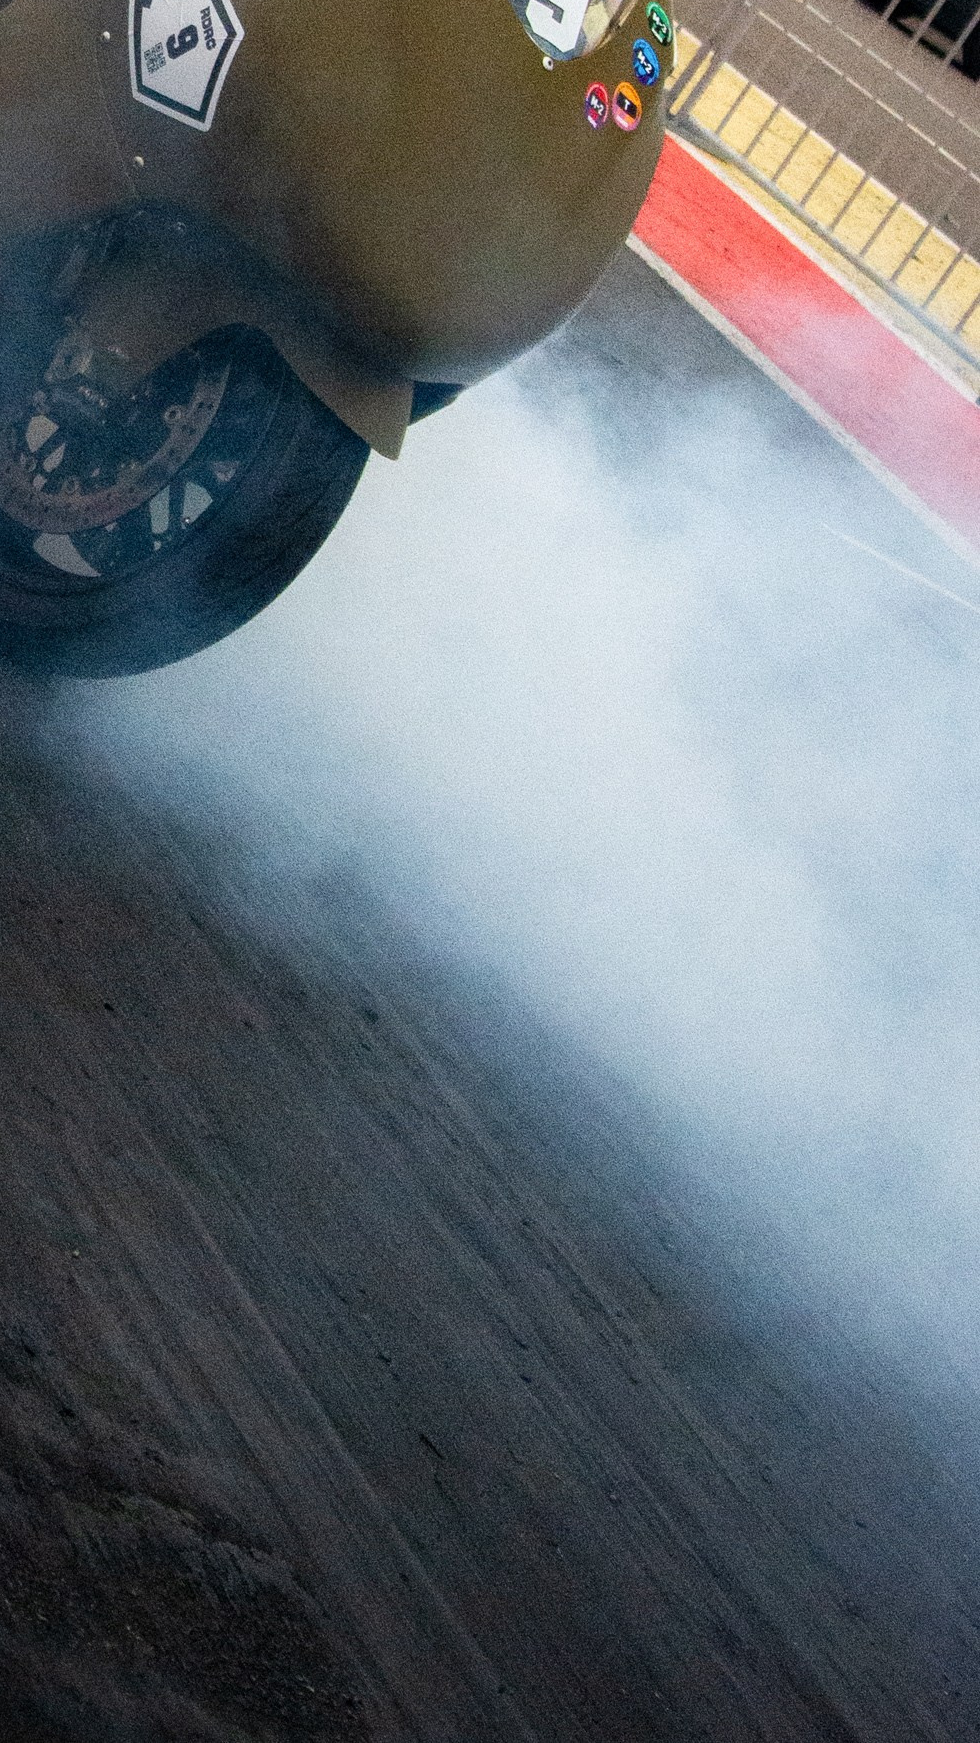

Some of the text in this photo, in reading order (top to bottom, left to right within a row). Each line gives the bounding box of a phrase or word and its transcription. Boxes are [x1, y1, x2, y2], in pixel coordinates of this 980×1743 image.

[166, 24, 199, 60] 9
[199, 6, 217, 51] RDRC
[623, 99, 631, 111] T
